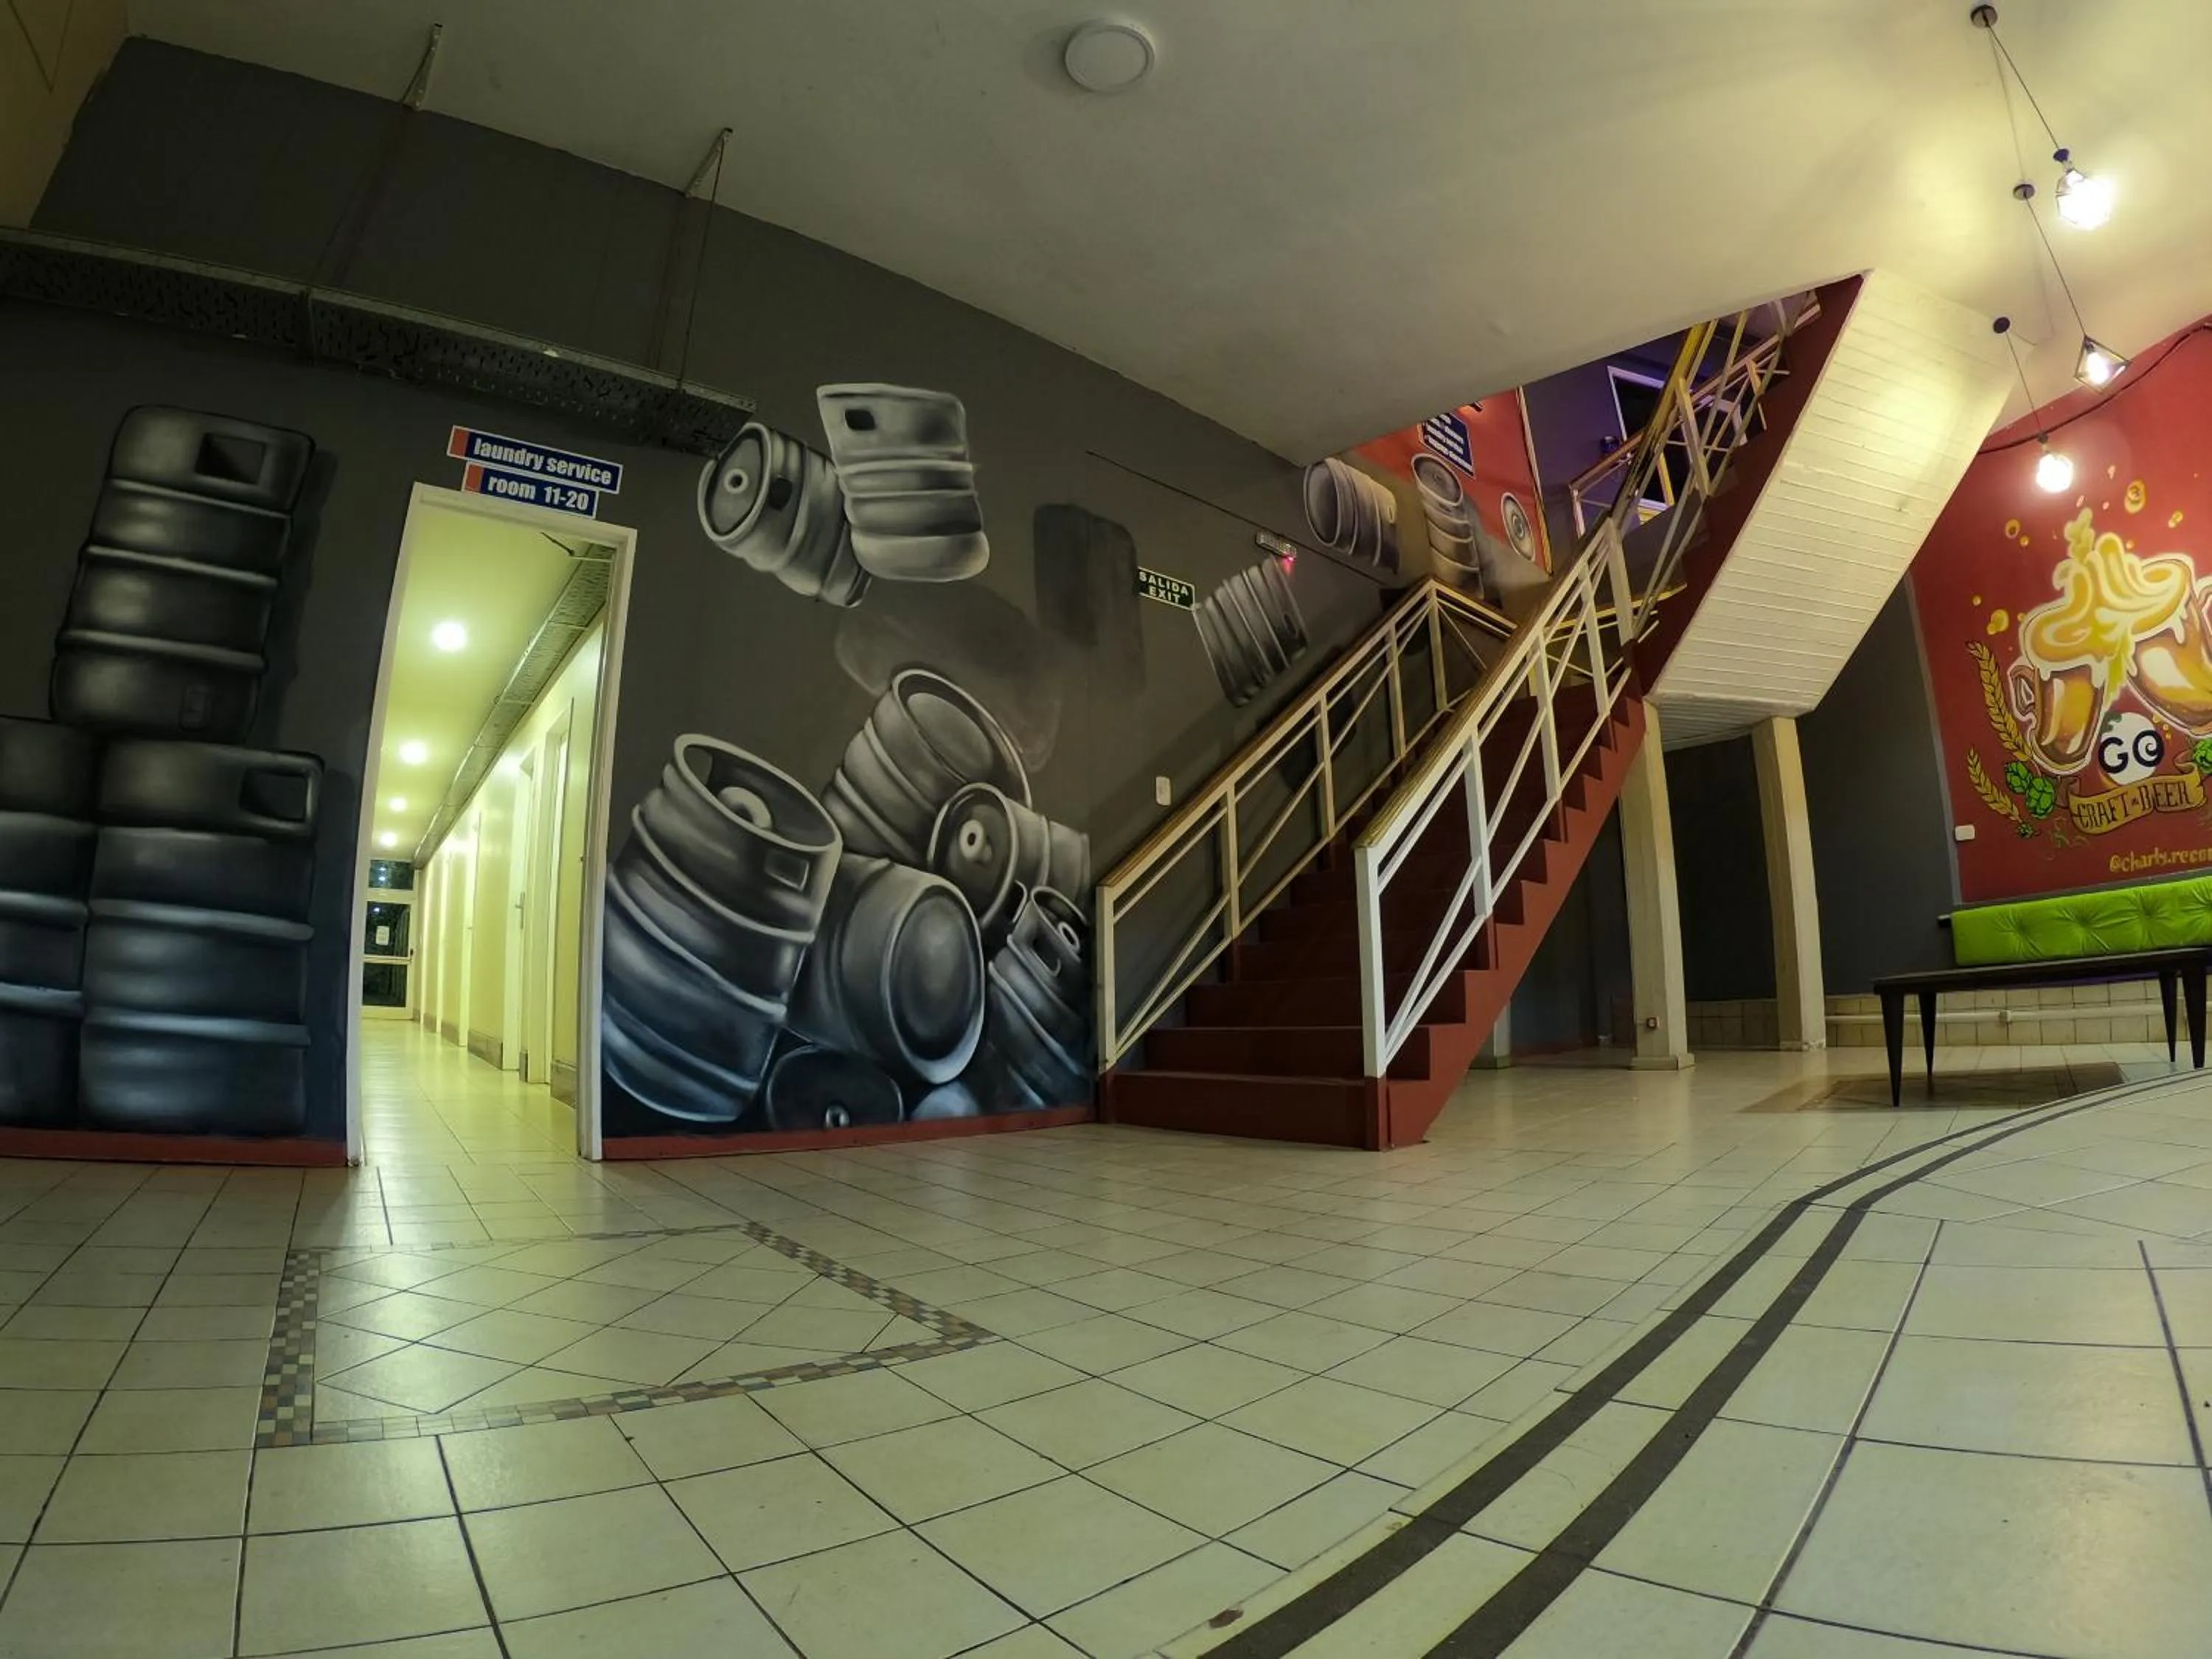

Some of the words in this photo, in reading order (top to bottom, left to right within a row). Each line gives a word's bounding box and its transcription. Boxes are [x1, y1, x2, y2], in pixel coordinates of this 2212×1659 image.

[473, 438, 544, 471] laundry
[546, 457, 611, 485] service
[487, 476, 536, 500] room
[543, 486, 589, 511] 11-20
[1139, 571, 1189, 596] SALIDA
[1149, 585, 1180, 603] EXIT
[2077, 792, 2129, 828] CRAFT
[2138, 781, 2191, 811] BEER
